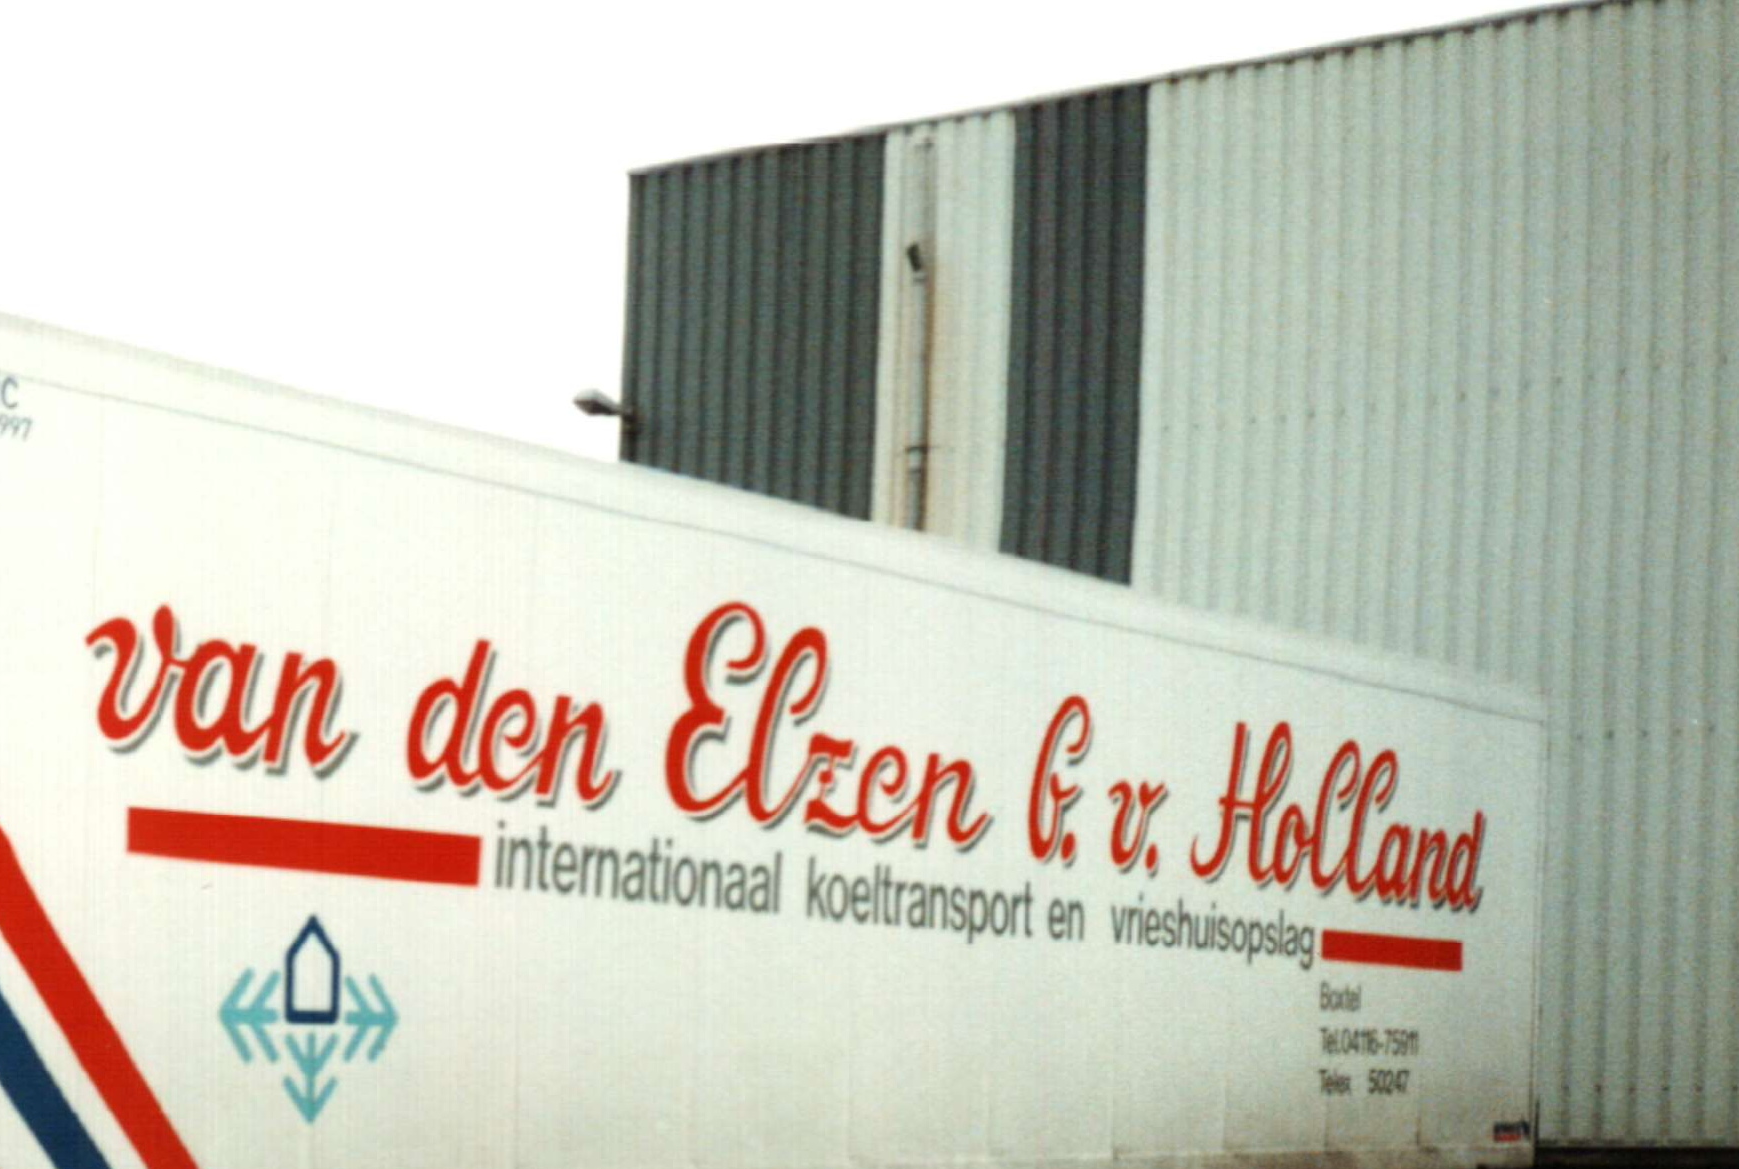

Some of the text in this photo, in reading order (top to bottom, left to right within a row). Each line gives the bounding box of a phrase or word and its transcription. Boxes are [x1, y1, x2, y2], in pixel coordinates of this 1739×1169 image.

[85, 604, 354, 774] van
[406, 639, 618, 806] den
[665, 602, 992, 848] Elzen
[1190, 720, 1486, 910] Holland
[493, 820, 1316, 972] internationaal koeltransport en vrieshuisopslag
[1319, 981, 1362, 1011] Boxtel
[1319, 1068, 1352, 1095] Telex
